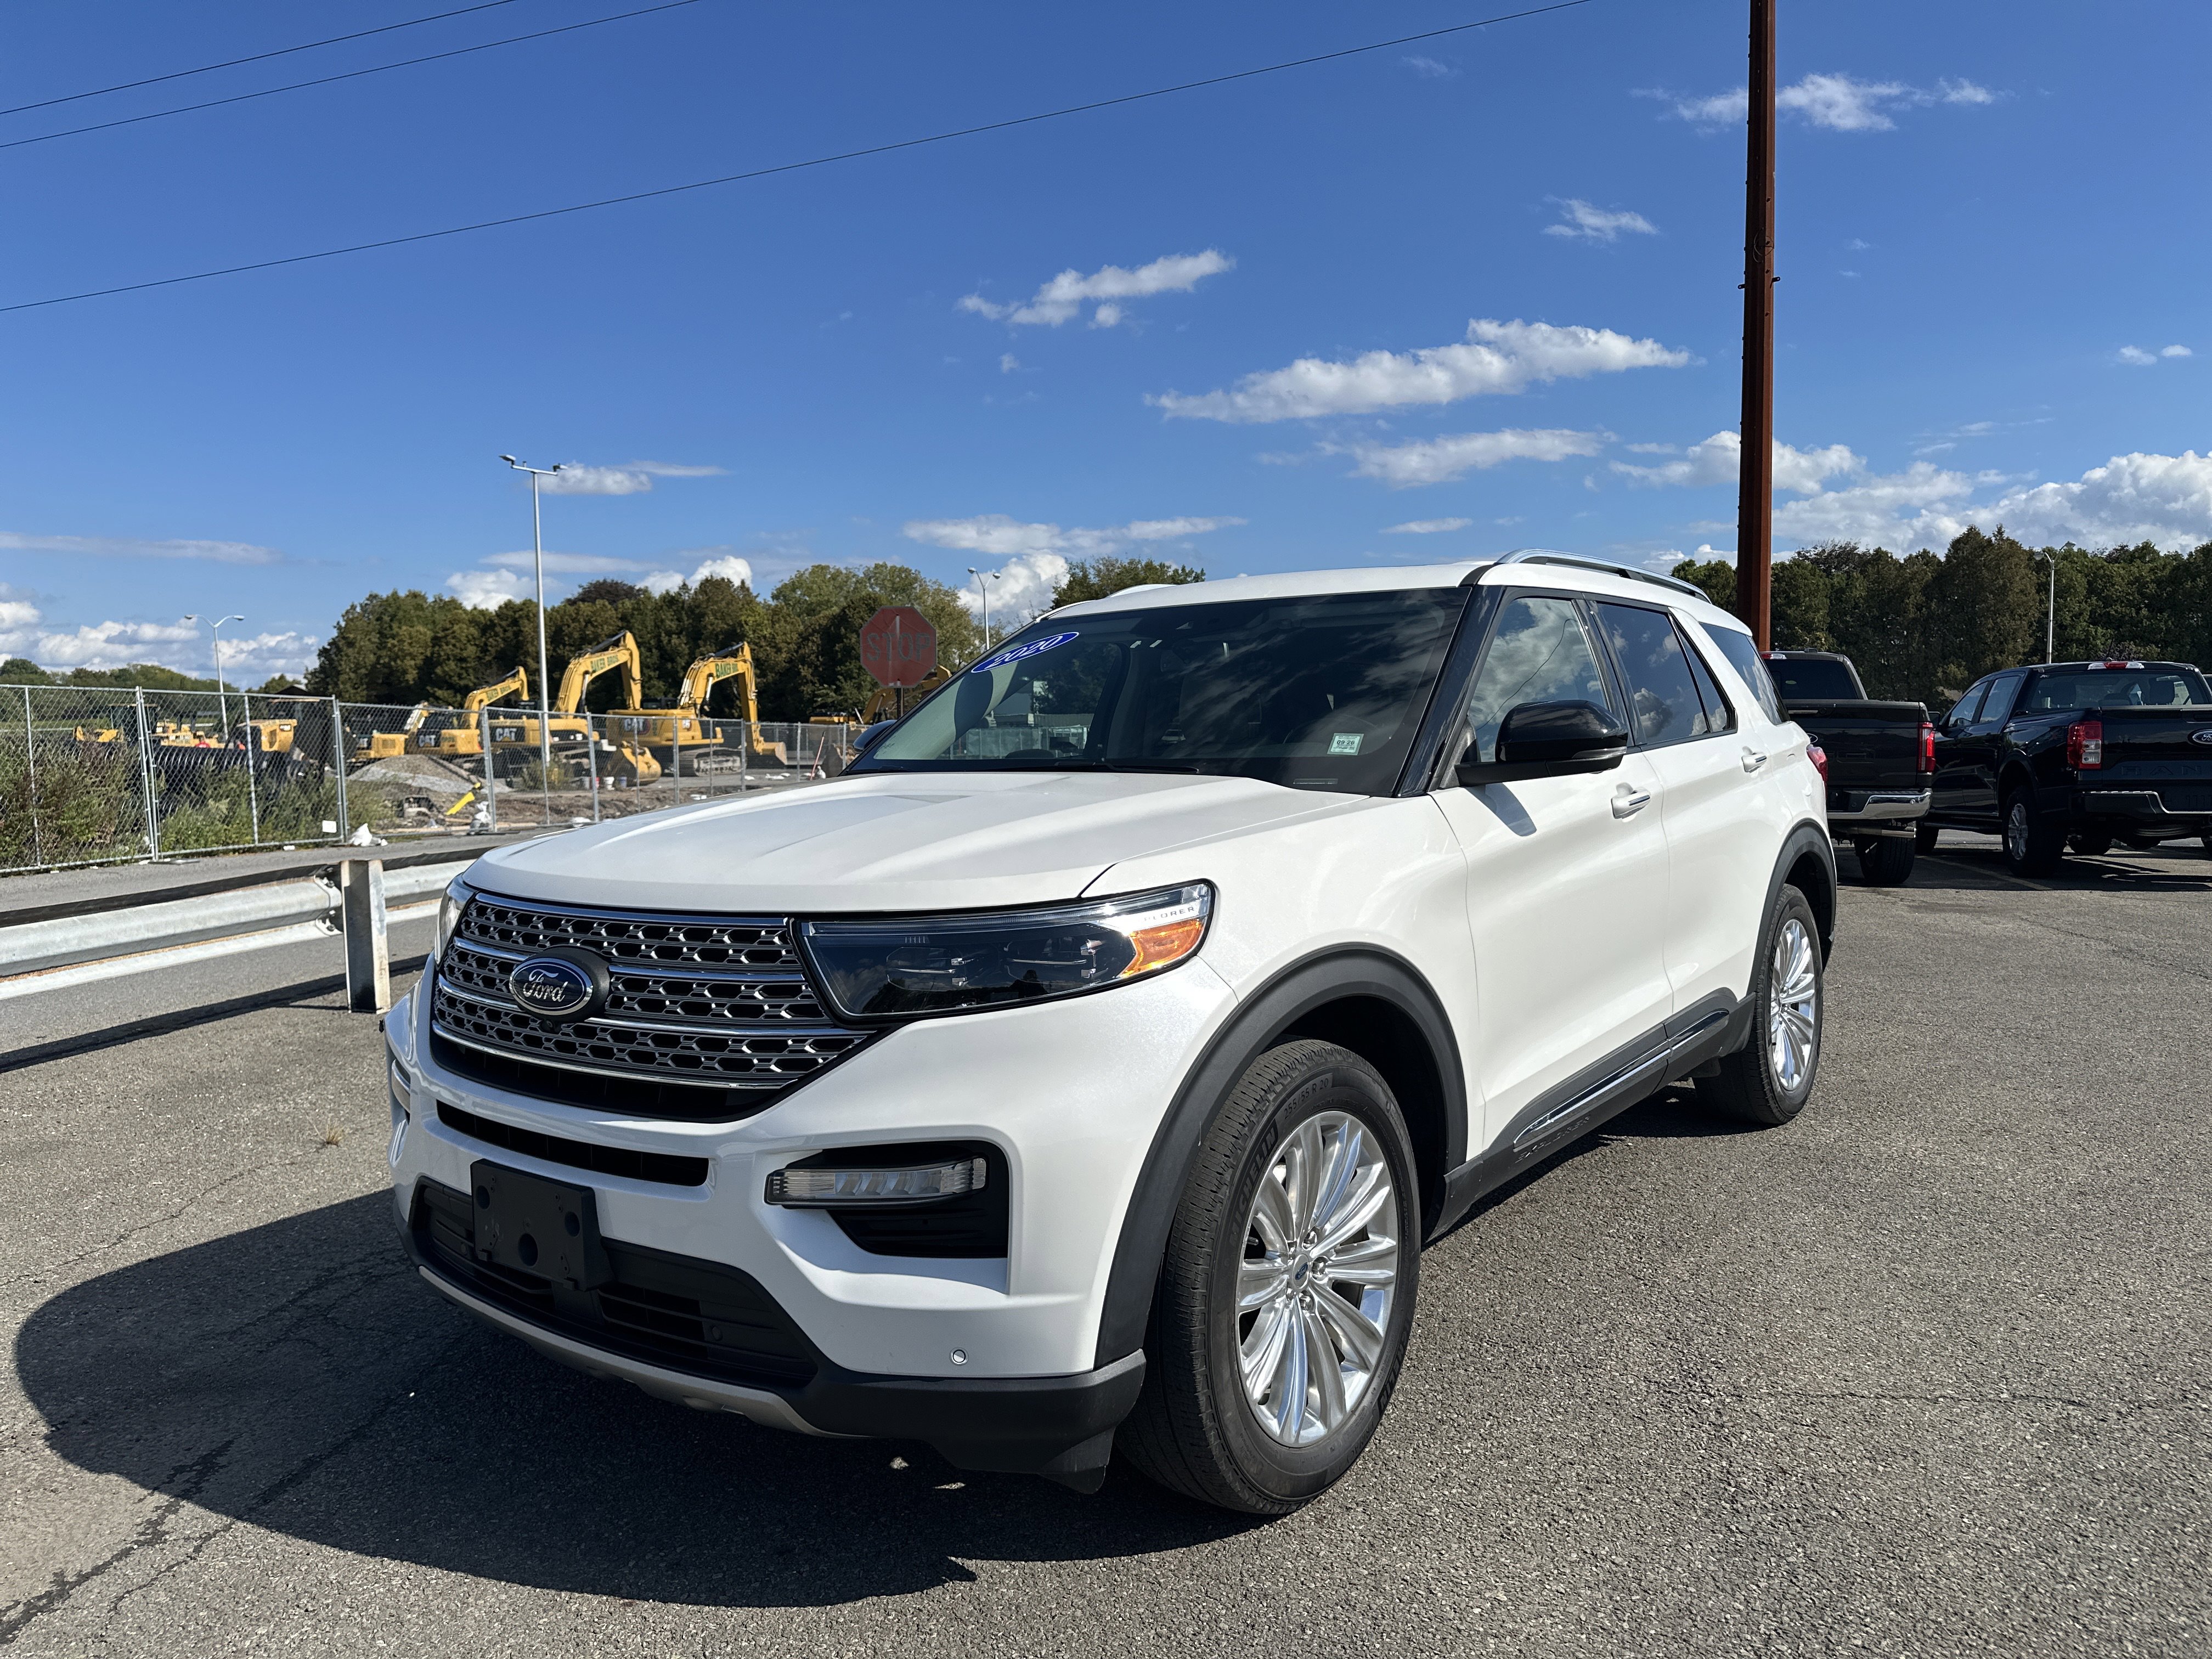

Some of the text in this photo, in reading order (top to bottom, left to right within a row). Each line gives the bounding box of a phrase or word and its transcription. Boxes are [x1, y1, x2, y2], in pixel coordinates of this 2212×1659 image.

[867, 633, 930, 661] STOP
[984, 635, 1063, 670] 2020
[715, 663, 731, 679] BAKER
[624, 718, 645, 732] CAT
[418, 735, 436, 747] CAT
[495, 728, 517, 742] CAT
[2201, 733, 2212, 741] Fo
[2121, 766, 2202, 776] RAN
[523, 968, 569, 1002] Ford
[1284, 1086, 1310, 1120] 255/55
[1312, 1082, 1317, 1094] R
[1319, 1077, 1329, 1091] 20
[1229, 1127, 1278, 1247] MICHELIN
